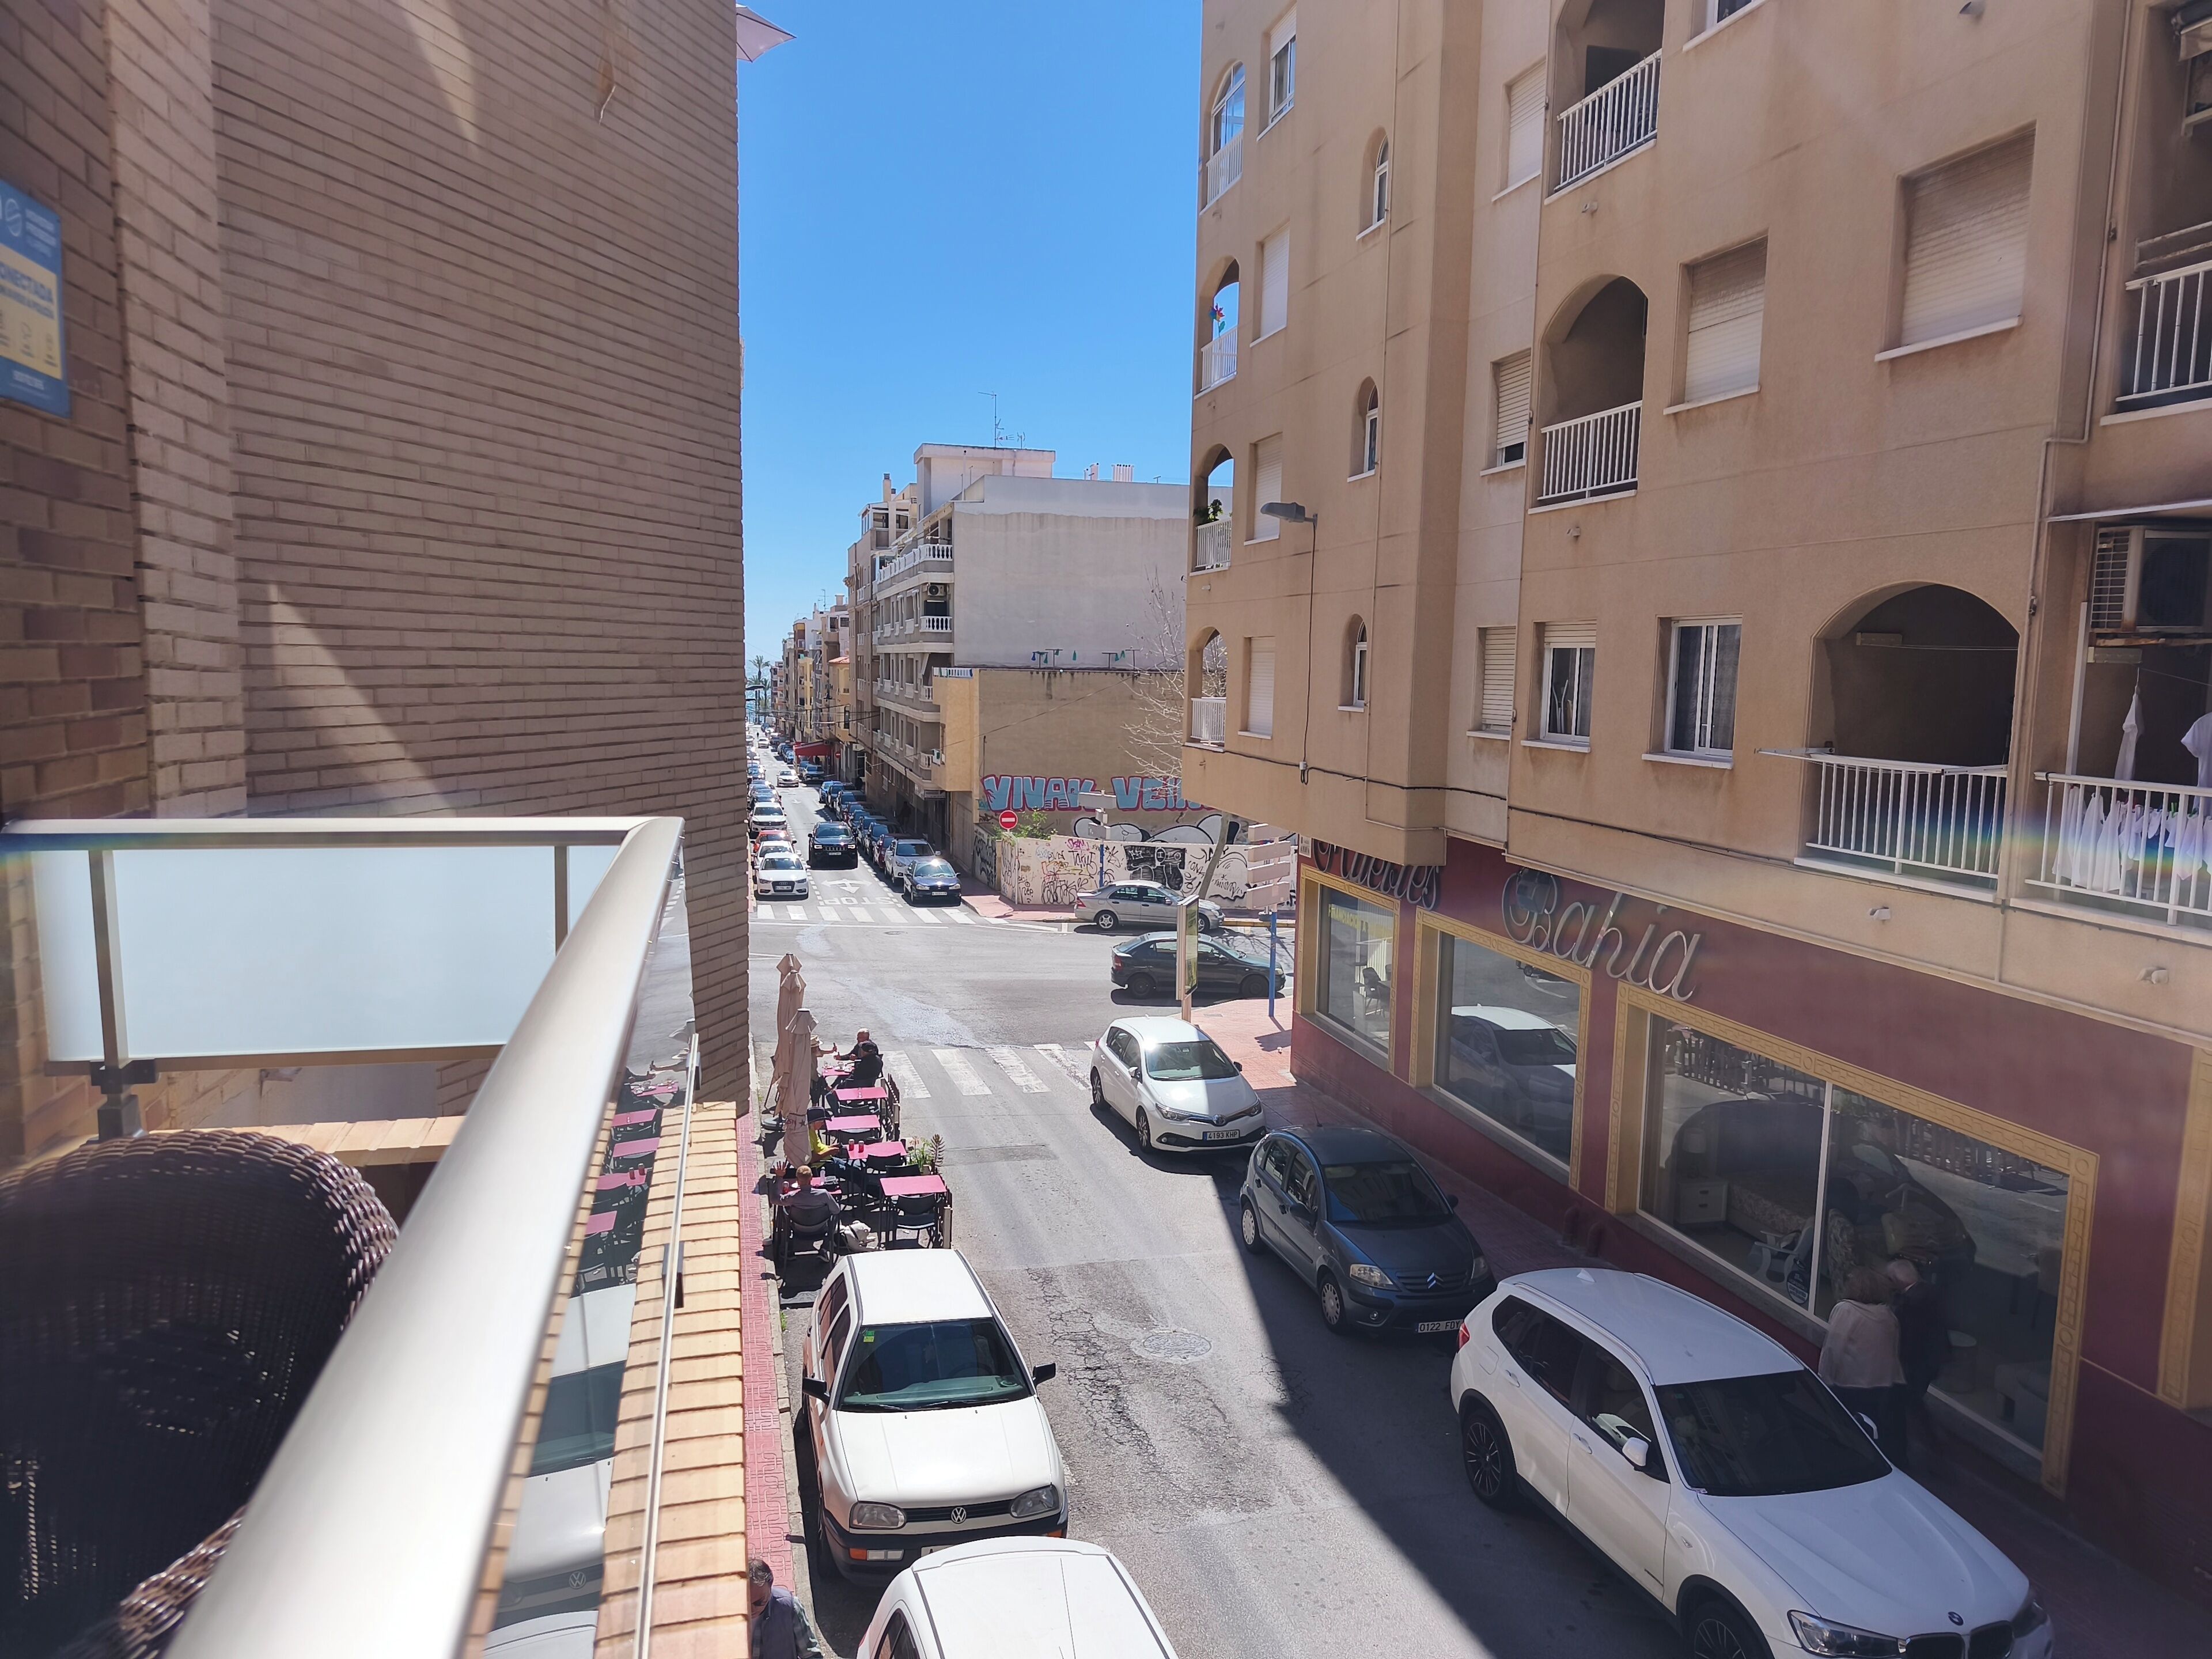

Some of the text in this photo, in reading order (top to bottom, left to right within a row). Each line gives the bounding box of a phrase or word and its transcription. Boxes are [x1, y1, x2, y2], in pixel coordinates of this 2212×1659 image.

[824, 896, 895, 905] STOP
[1419, 1320, 1461, 1332] 0122 FDY
